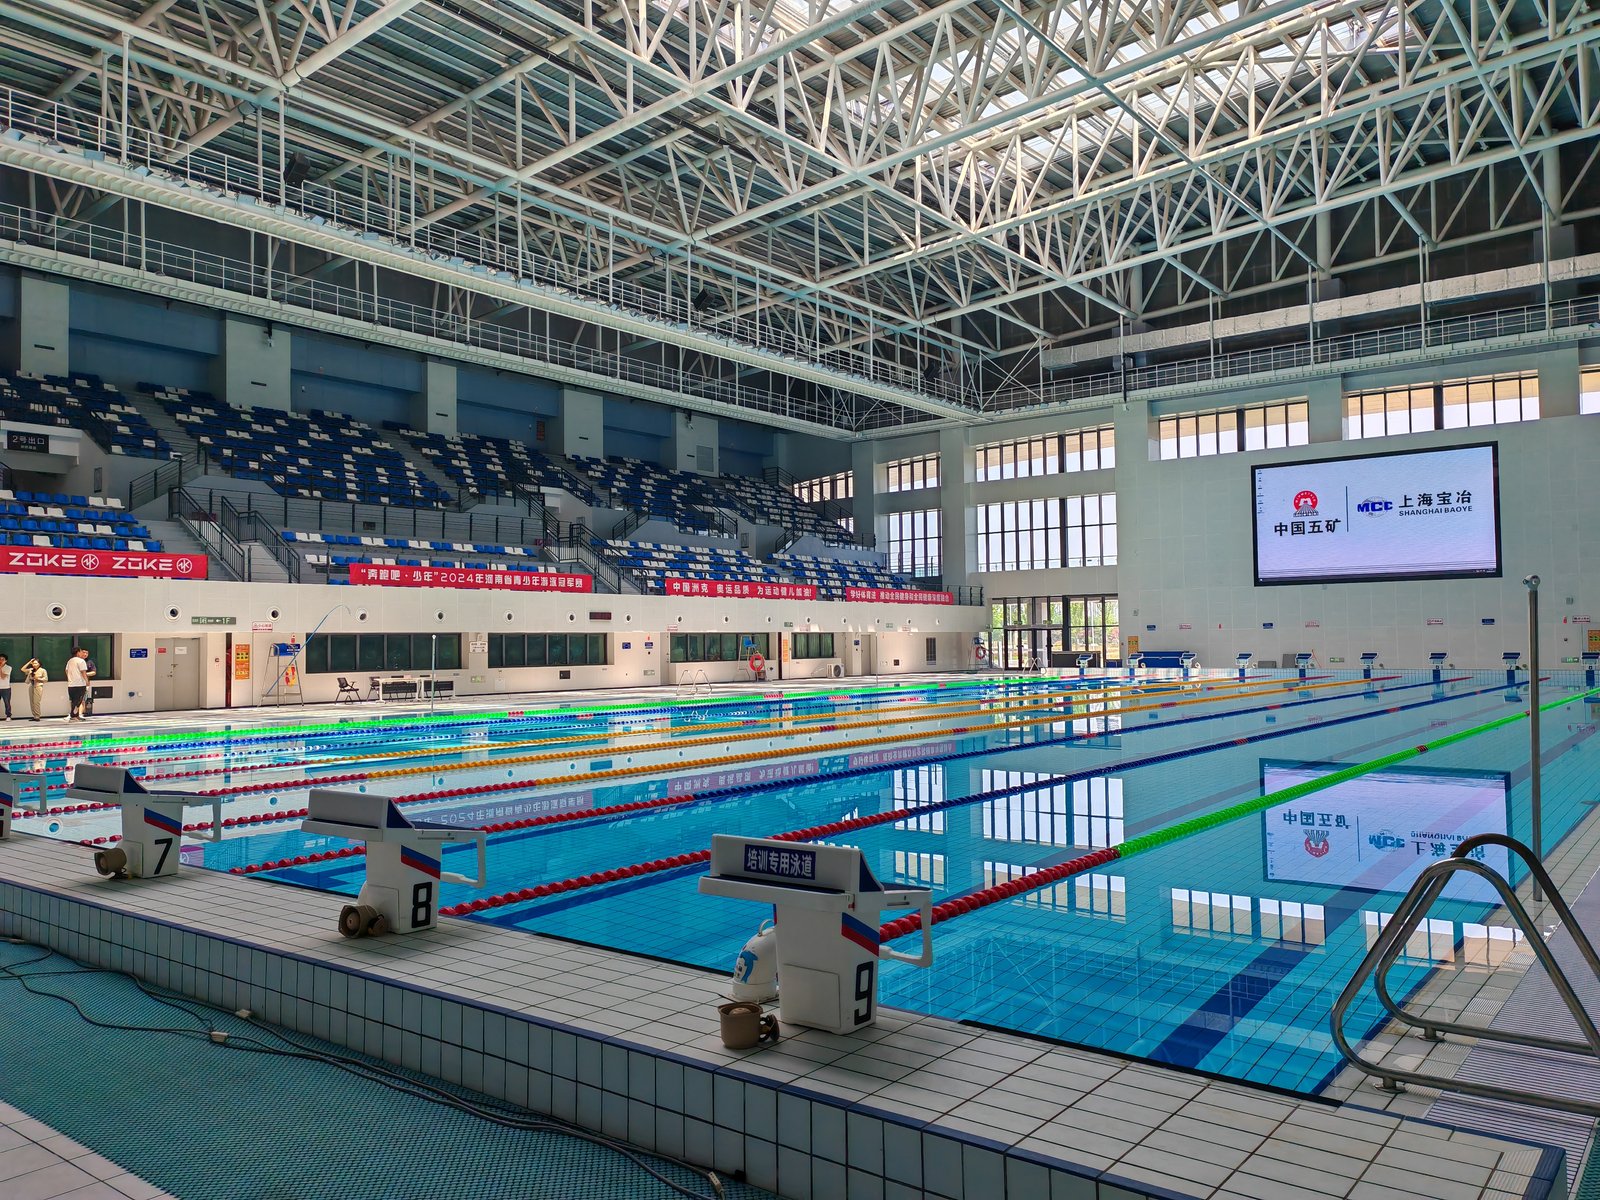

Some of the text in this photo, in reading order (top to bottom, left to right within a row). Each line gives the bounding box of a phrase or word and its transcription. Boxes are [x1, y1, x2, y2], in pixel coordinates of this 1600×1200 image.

[12, 435, 45, 445] 2号出口
[1357, 501, 1393, 513] MCC
[1399, 490, 1473, 508] 上海宝冶
[1399, 505, 1473, 517] SHANGHAI BAOYE
[1274, 518, 1342, 537] 中国五矿
[154, 838, 173, 875] 7
[747, 850, 814, 878] 培训专用泳道
[411, 881, 433, 929] 8
[854, 961, 874, 1026] 9
